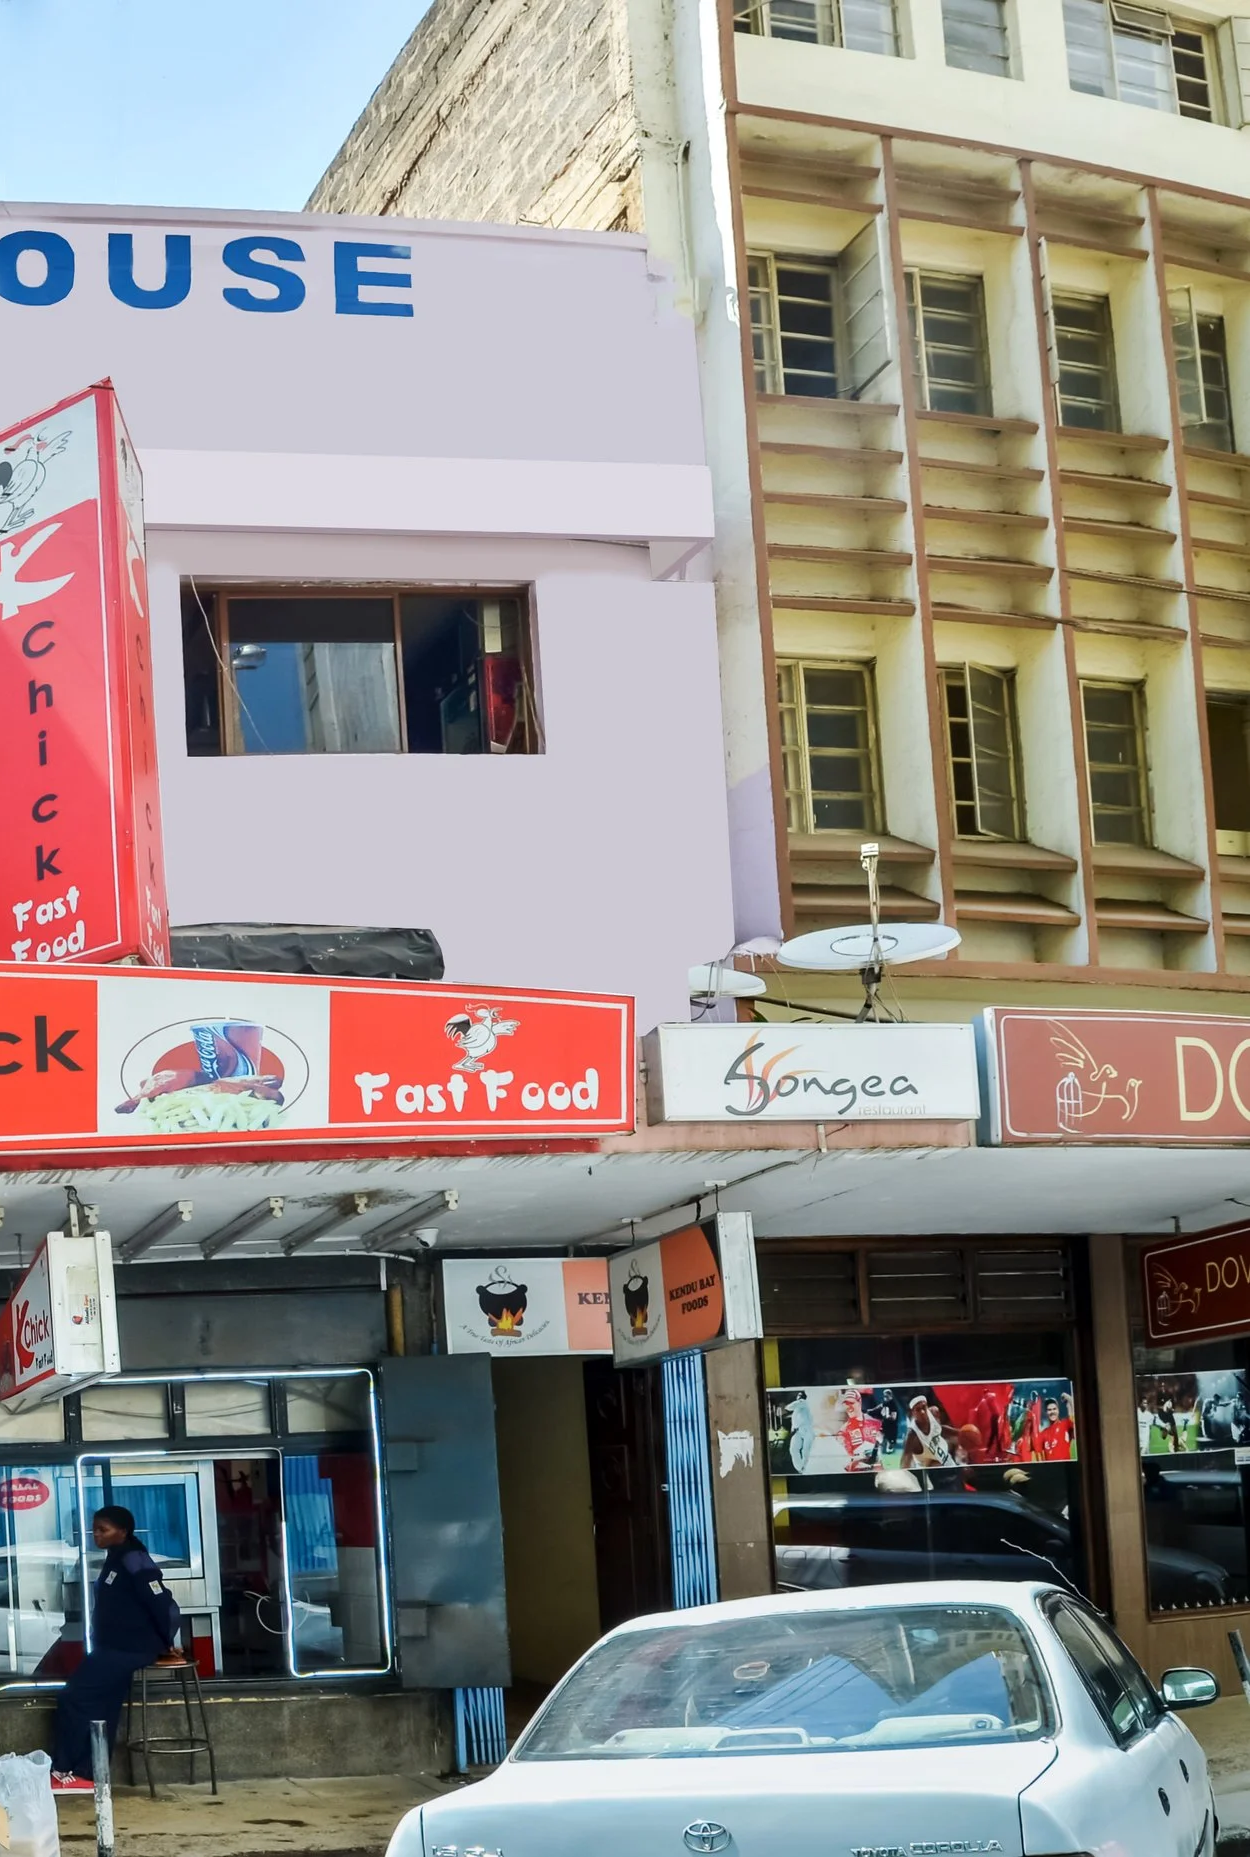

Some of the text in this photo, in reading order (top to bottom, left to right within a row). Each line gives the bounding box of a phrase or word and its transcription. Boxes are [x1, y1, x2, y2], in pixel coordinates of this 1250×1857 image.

[12, 885, 80, 932] Fast
[11, 919, 85, 961] Food
[354, 1068, 599, 1115] Fast Food
[723, 1042, 919, 1116] Songea
[857, 1103, 926, 1116] restaurant
[669, 1274, 716, 1301] KENDU BAY
[681, 1295, 709, 1315] FOODS
[24, 1309, 50, 1349] Chick
[910, 1839, 1003, 1856] COROLLA
